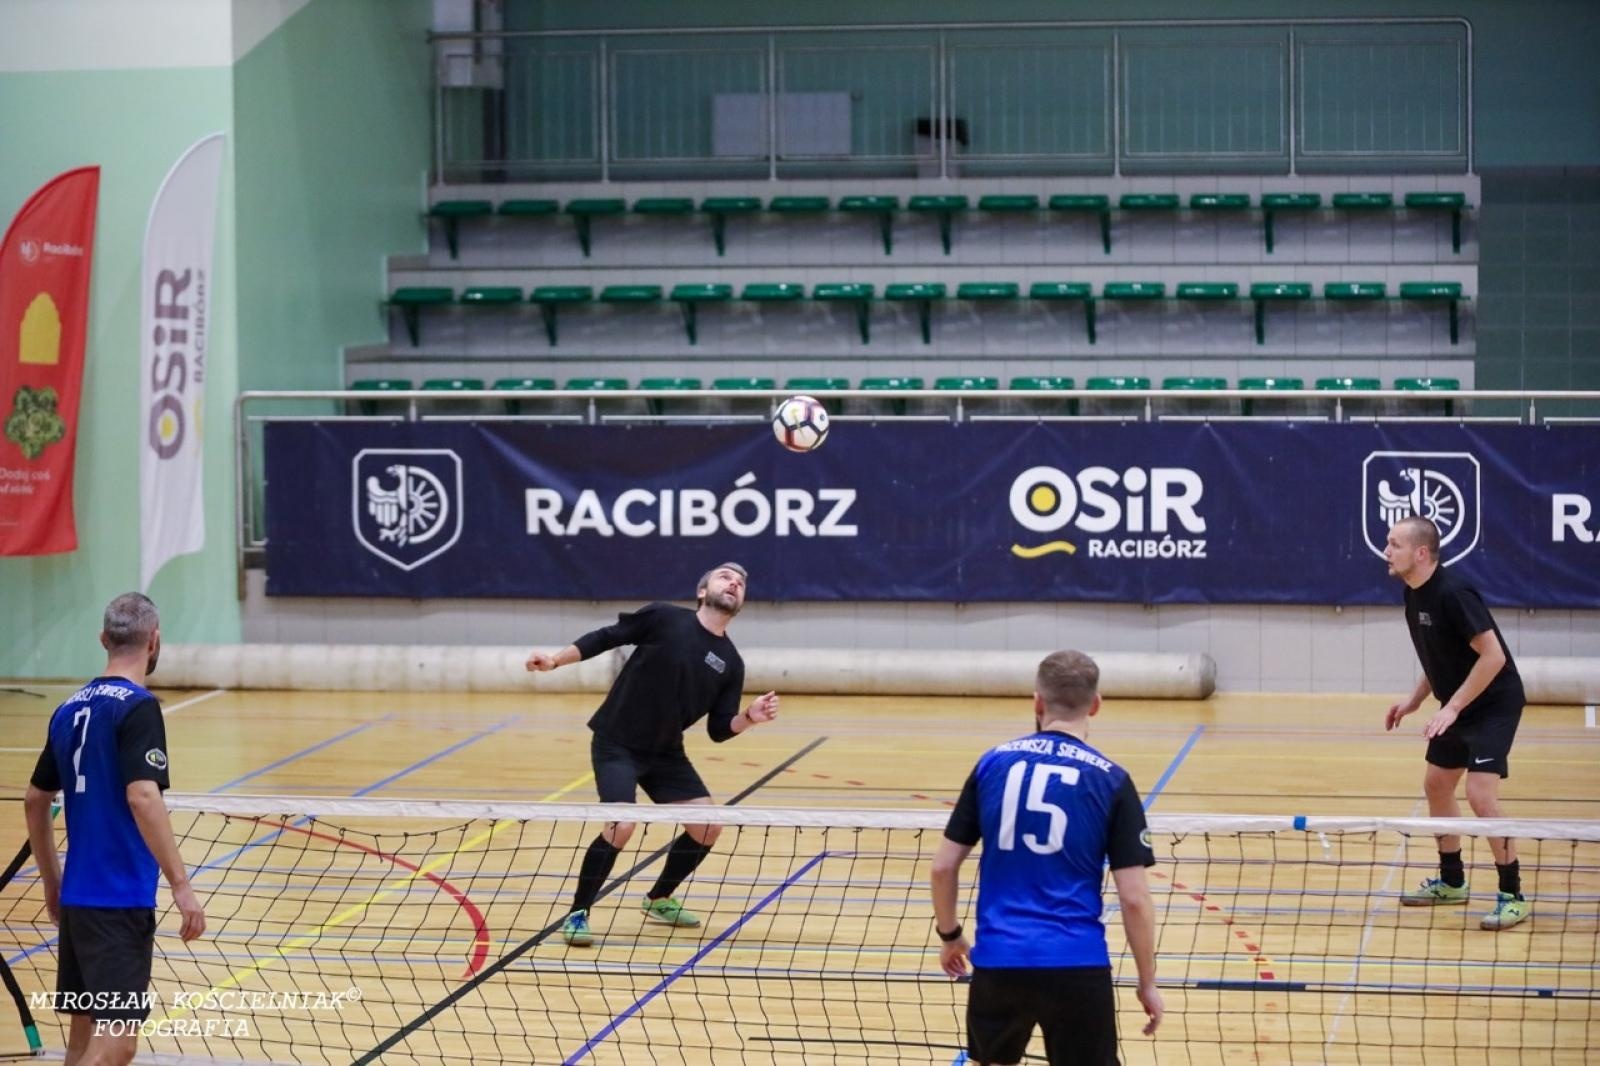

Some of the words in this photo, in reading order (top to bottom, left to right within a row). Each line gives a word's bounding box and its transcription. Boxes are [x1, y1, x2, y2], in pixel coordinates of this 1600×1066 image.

[149, 268, 192, 460] OSiR
[525, 471, 858, 537] RACIBÓRZ
[1009, 466, 1207, 533] OSiR
[1552, 493, 1600, 543] R
[1088, 534, 1208, 559] RACIBÓRZ
[1056, 742, 1113, 773] SIEWIERZ
[998, 760, 1081, 855] 15
